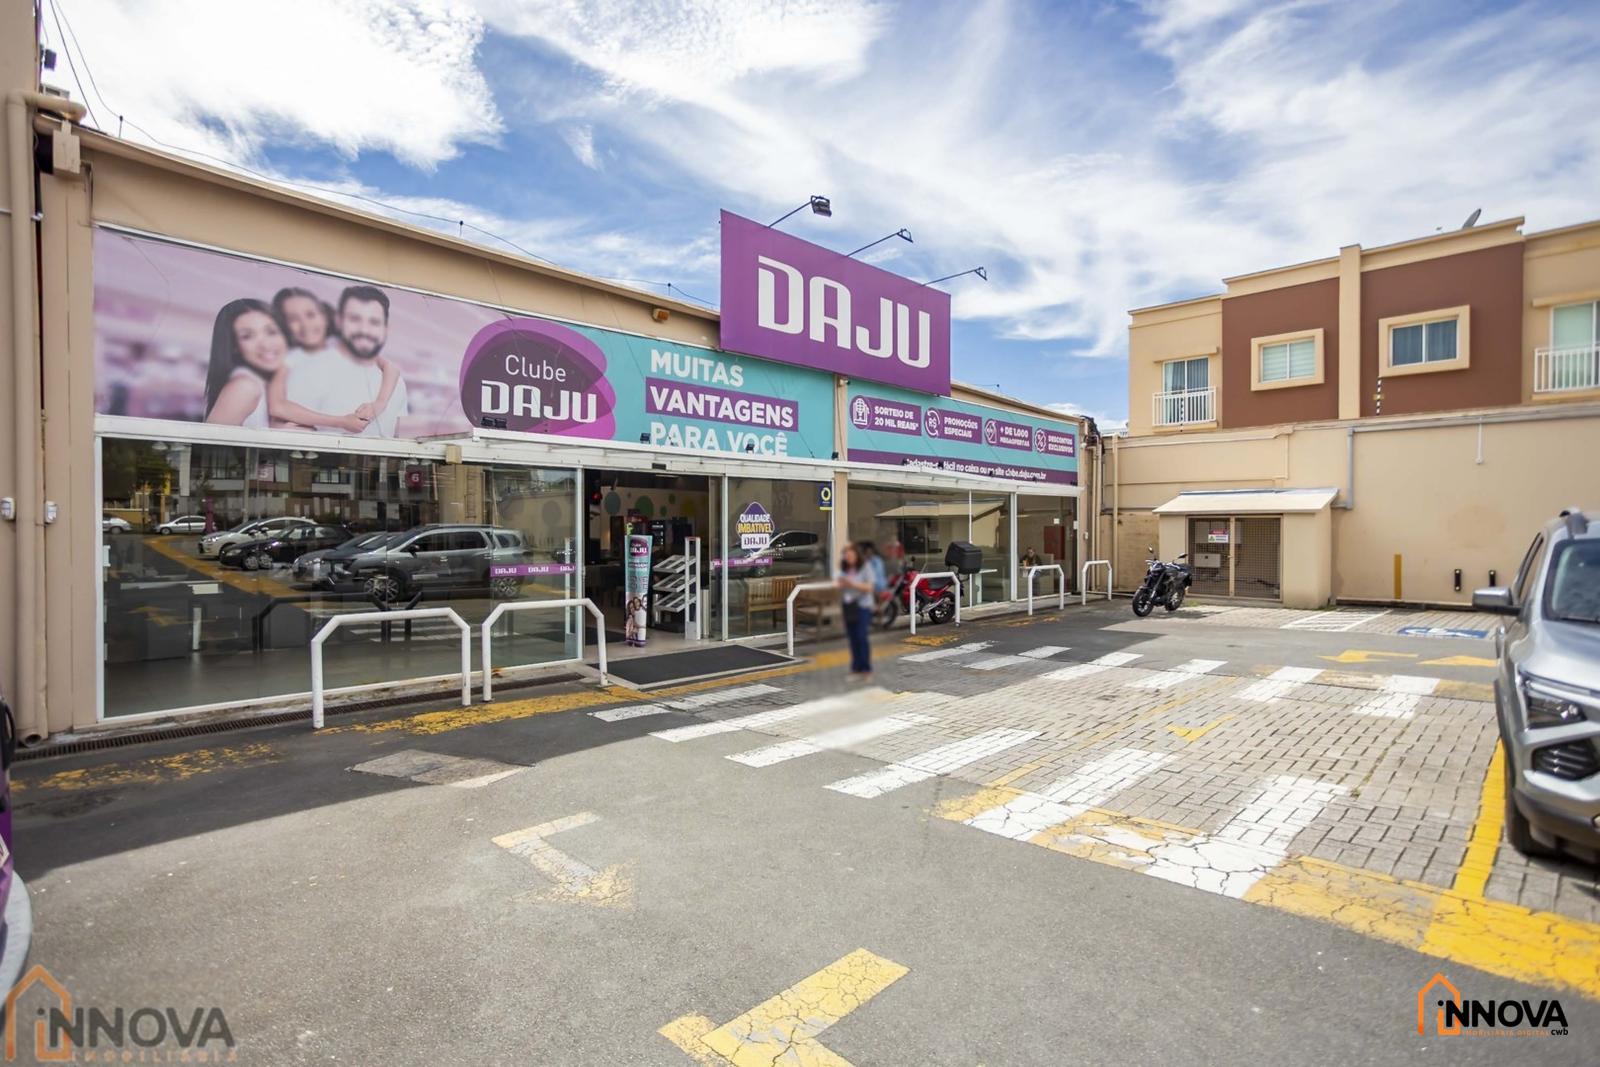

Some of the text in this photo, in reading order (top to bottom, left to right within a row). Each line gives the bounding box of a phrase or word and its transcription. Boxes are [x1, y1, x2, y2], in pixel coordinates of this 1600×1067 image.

[757, 254, 931, 369] DAJU
[504, 354, 567, 383] Clube
[650, 349, 744, 388] MUITAS
[480, 380, 597, 424] DAJU
[650, 386, 794, 428] VANTAGENS
[874, 406, 914, 419] SORTEIO DE
[874, 417, 884, 426] 20
[885, 419, 896, 428] MIL
[1004, 427, 1012, 435] DE
[650, 421, 788, 457] PARA VOCÊ
[740, 513, 771, 523] QUALIDADE
[744, 537, 767, 545] DAJU
[495, 567, 517, 575] DAJU
